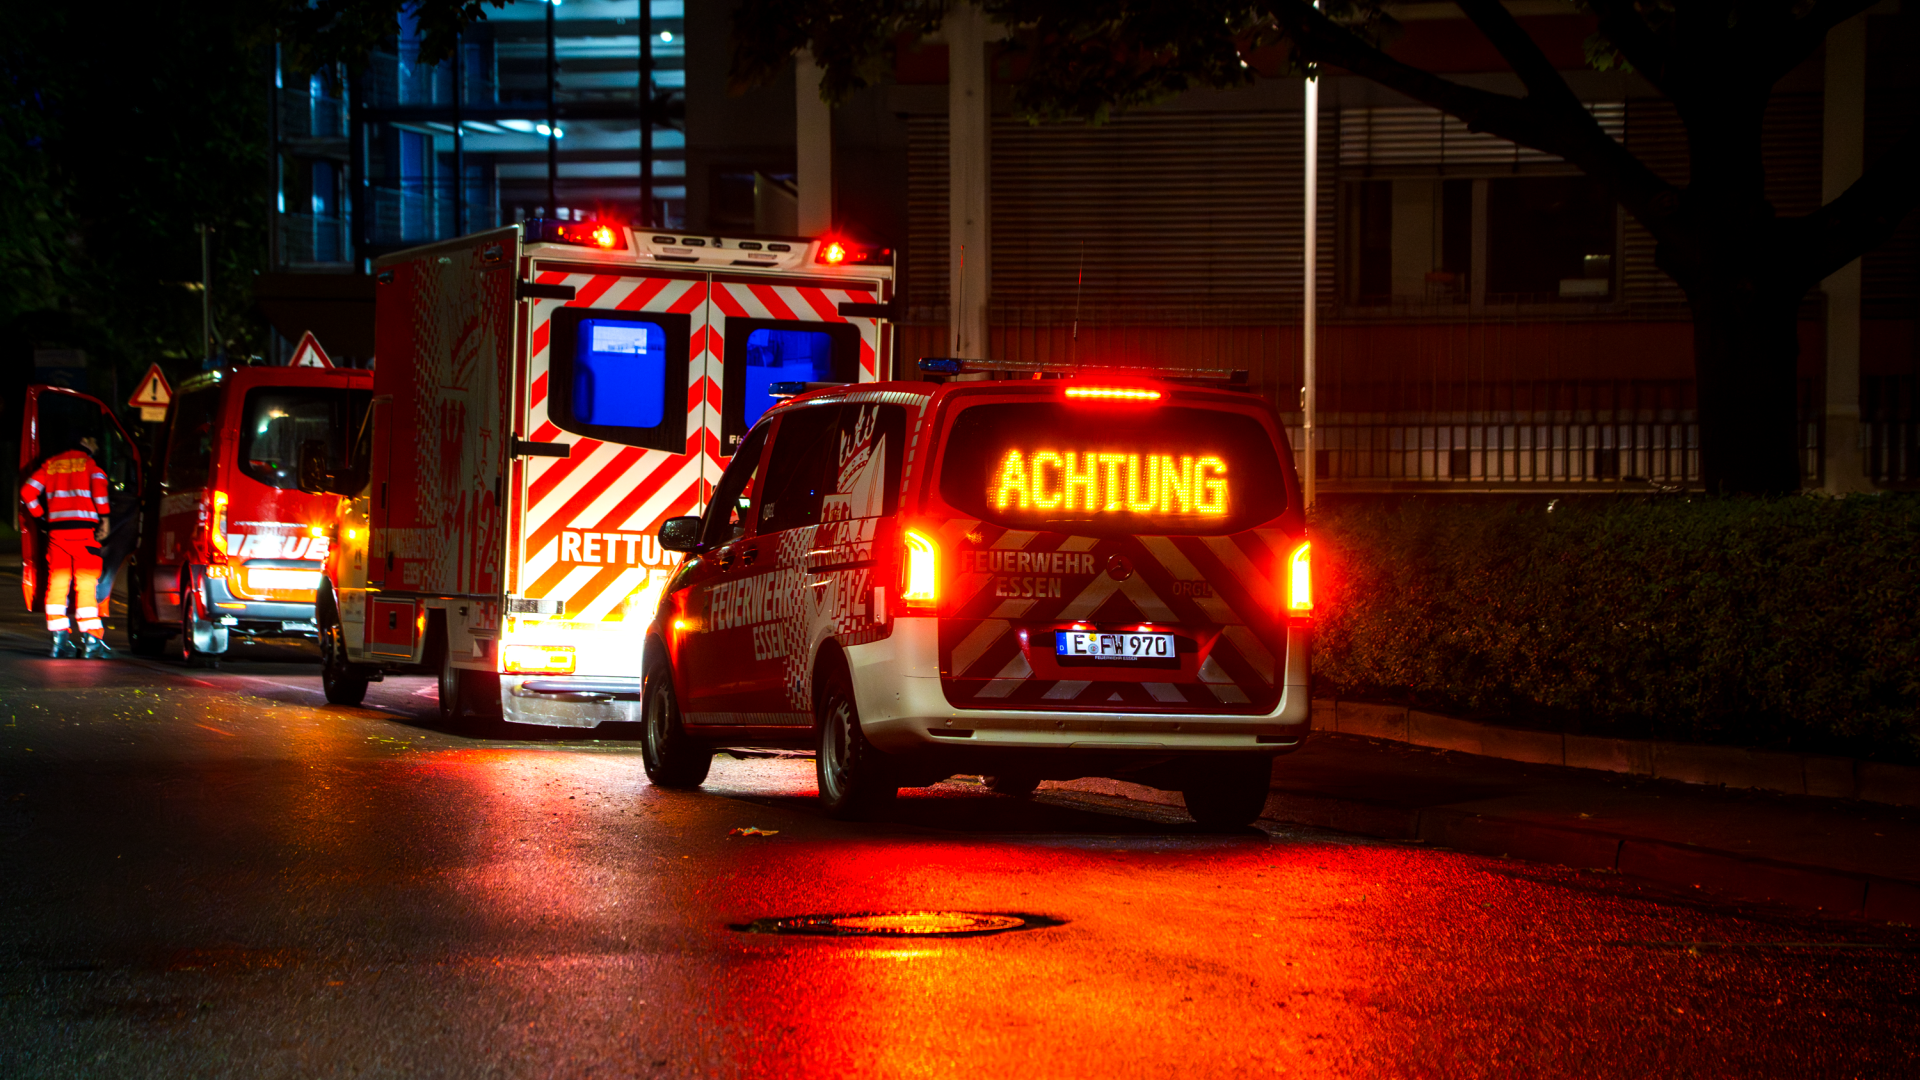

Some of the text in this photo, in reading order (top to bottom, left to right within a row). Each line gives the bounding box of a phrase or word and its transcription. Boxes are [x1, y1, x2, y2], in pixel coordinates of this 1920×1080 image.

[997, 449, 1227, 514] ACHTUNG
[453, 489, 494, 594] 112
[560, 530, 682, 566] RETTUN
[960, 550, 1096, 575] FEUERWEHR
[710, 567, 796, 632] FEUERWEHR
[995, 576, 1062, 598] ESSEN
[1172, 581, 1210, 597] ORGL
[752, 622, 790, 661] ESSEN
[1074, 634, 1167, 656] E FW 970
